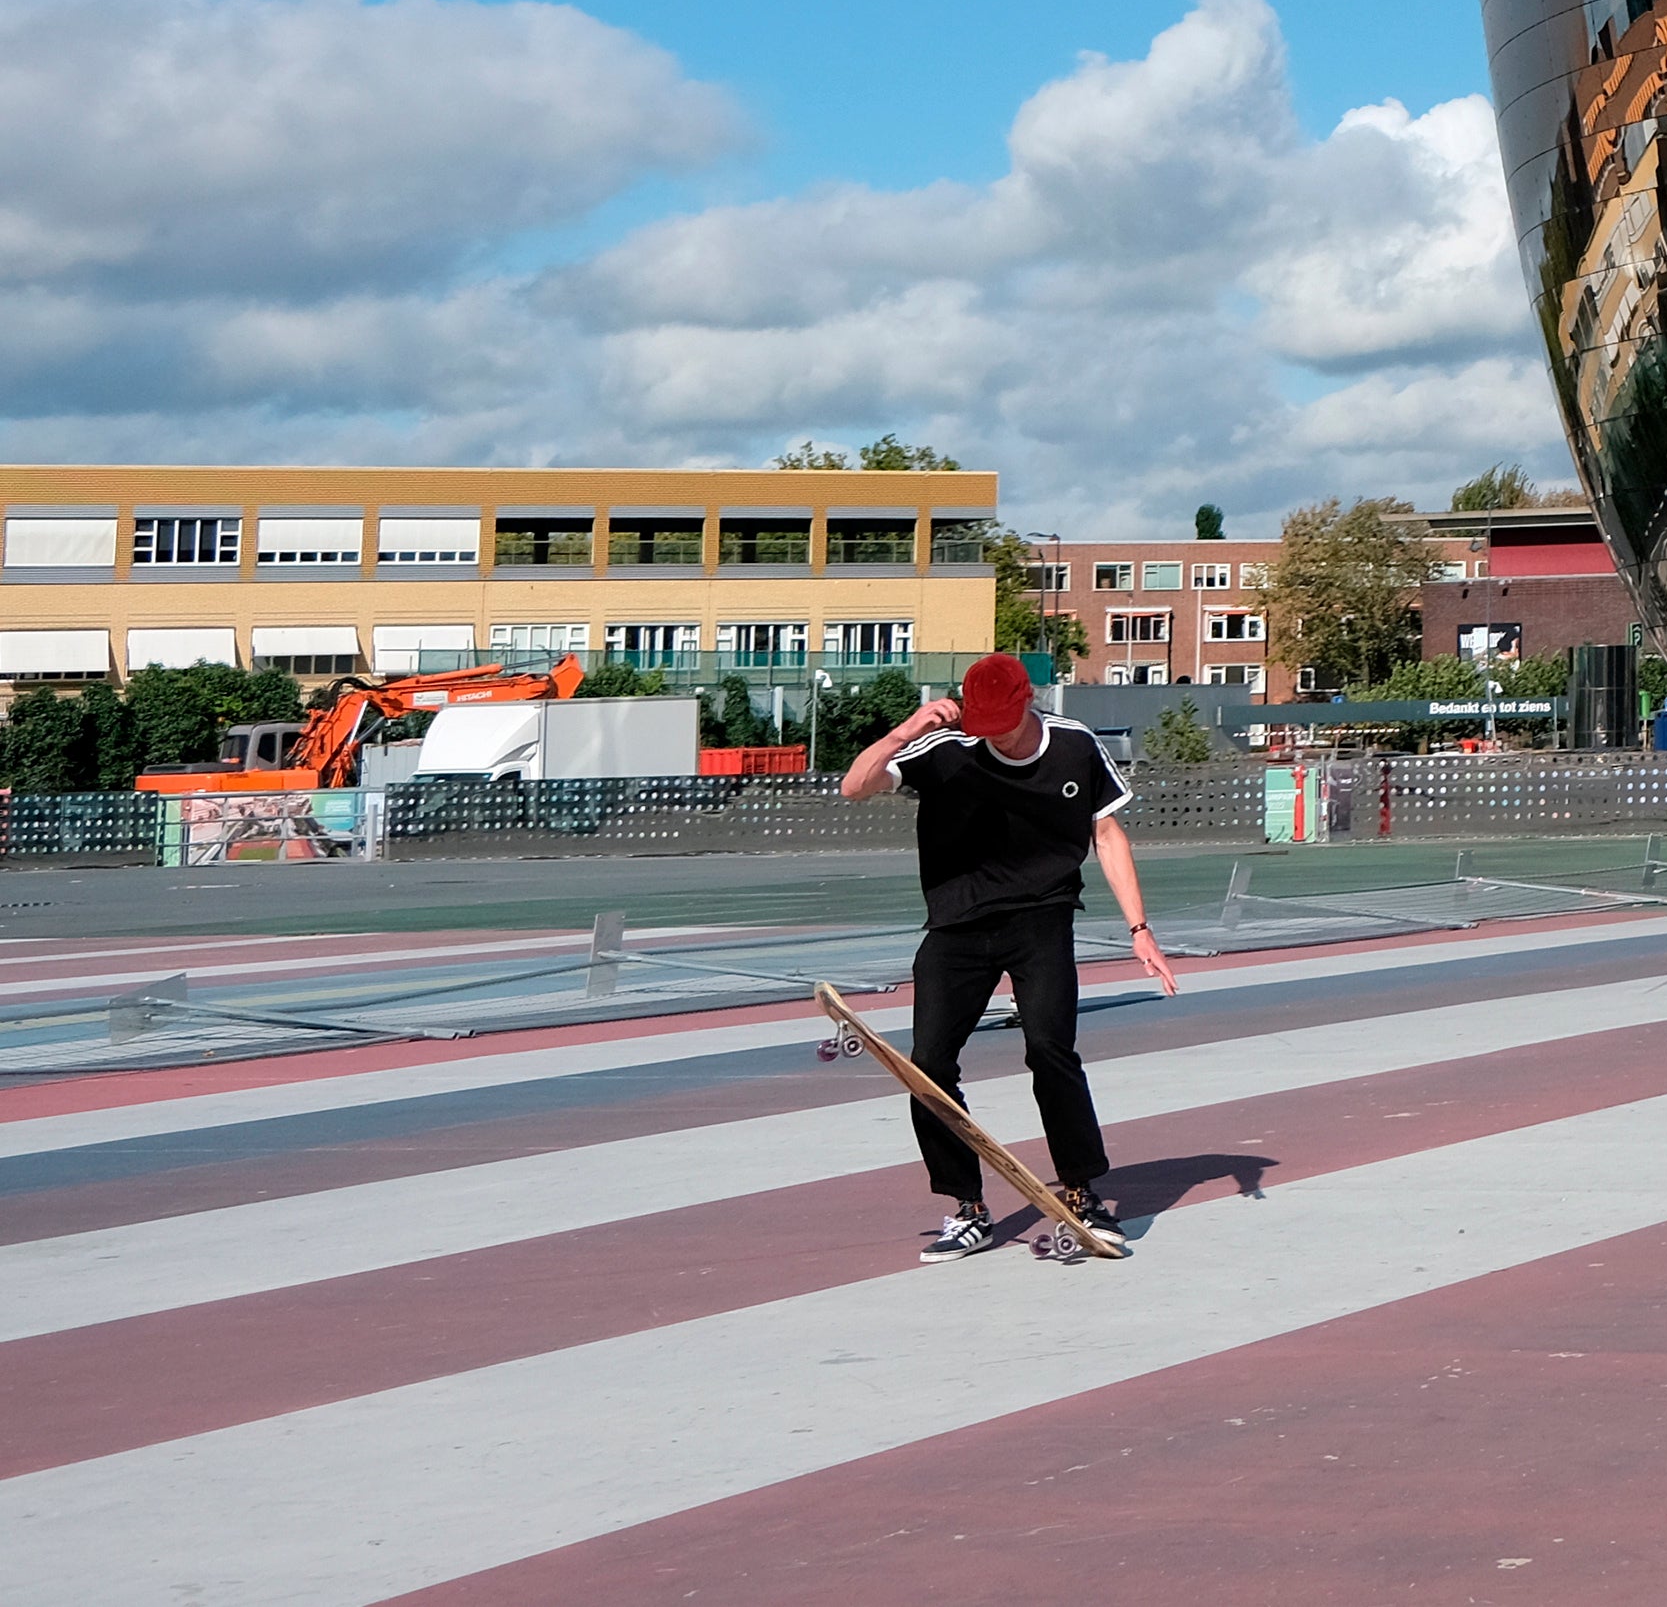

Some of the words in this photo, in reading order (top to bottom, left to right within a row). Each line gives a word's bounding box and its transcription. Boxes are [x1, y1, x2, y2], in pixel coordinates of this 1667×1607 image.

[456, 690, 493, 702] HITACHI
[1429, 701, 1480, 715] Bedankt
[1499, 701, 1518, 713] tot
[1518, 700, 1552, 713] ziens
